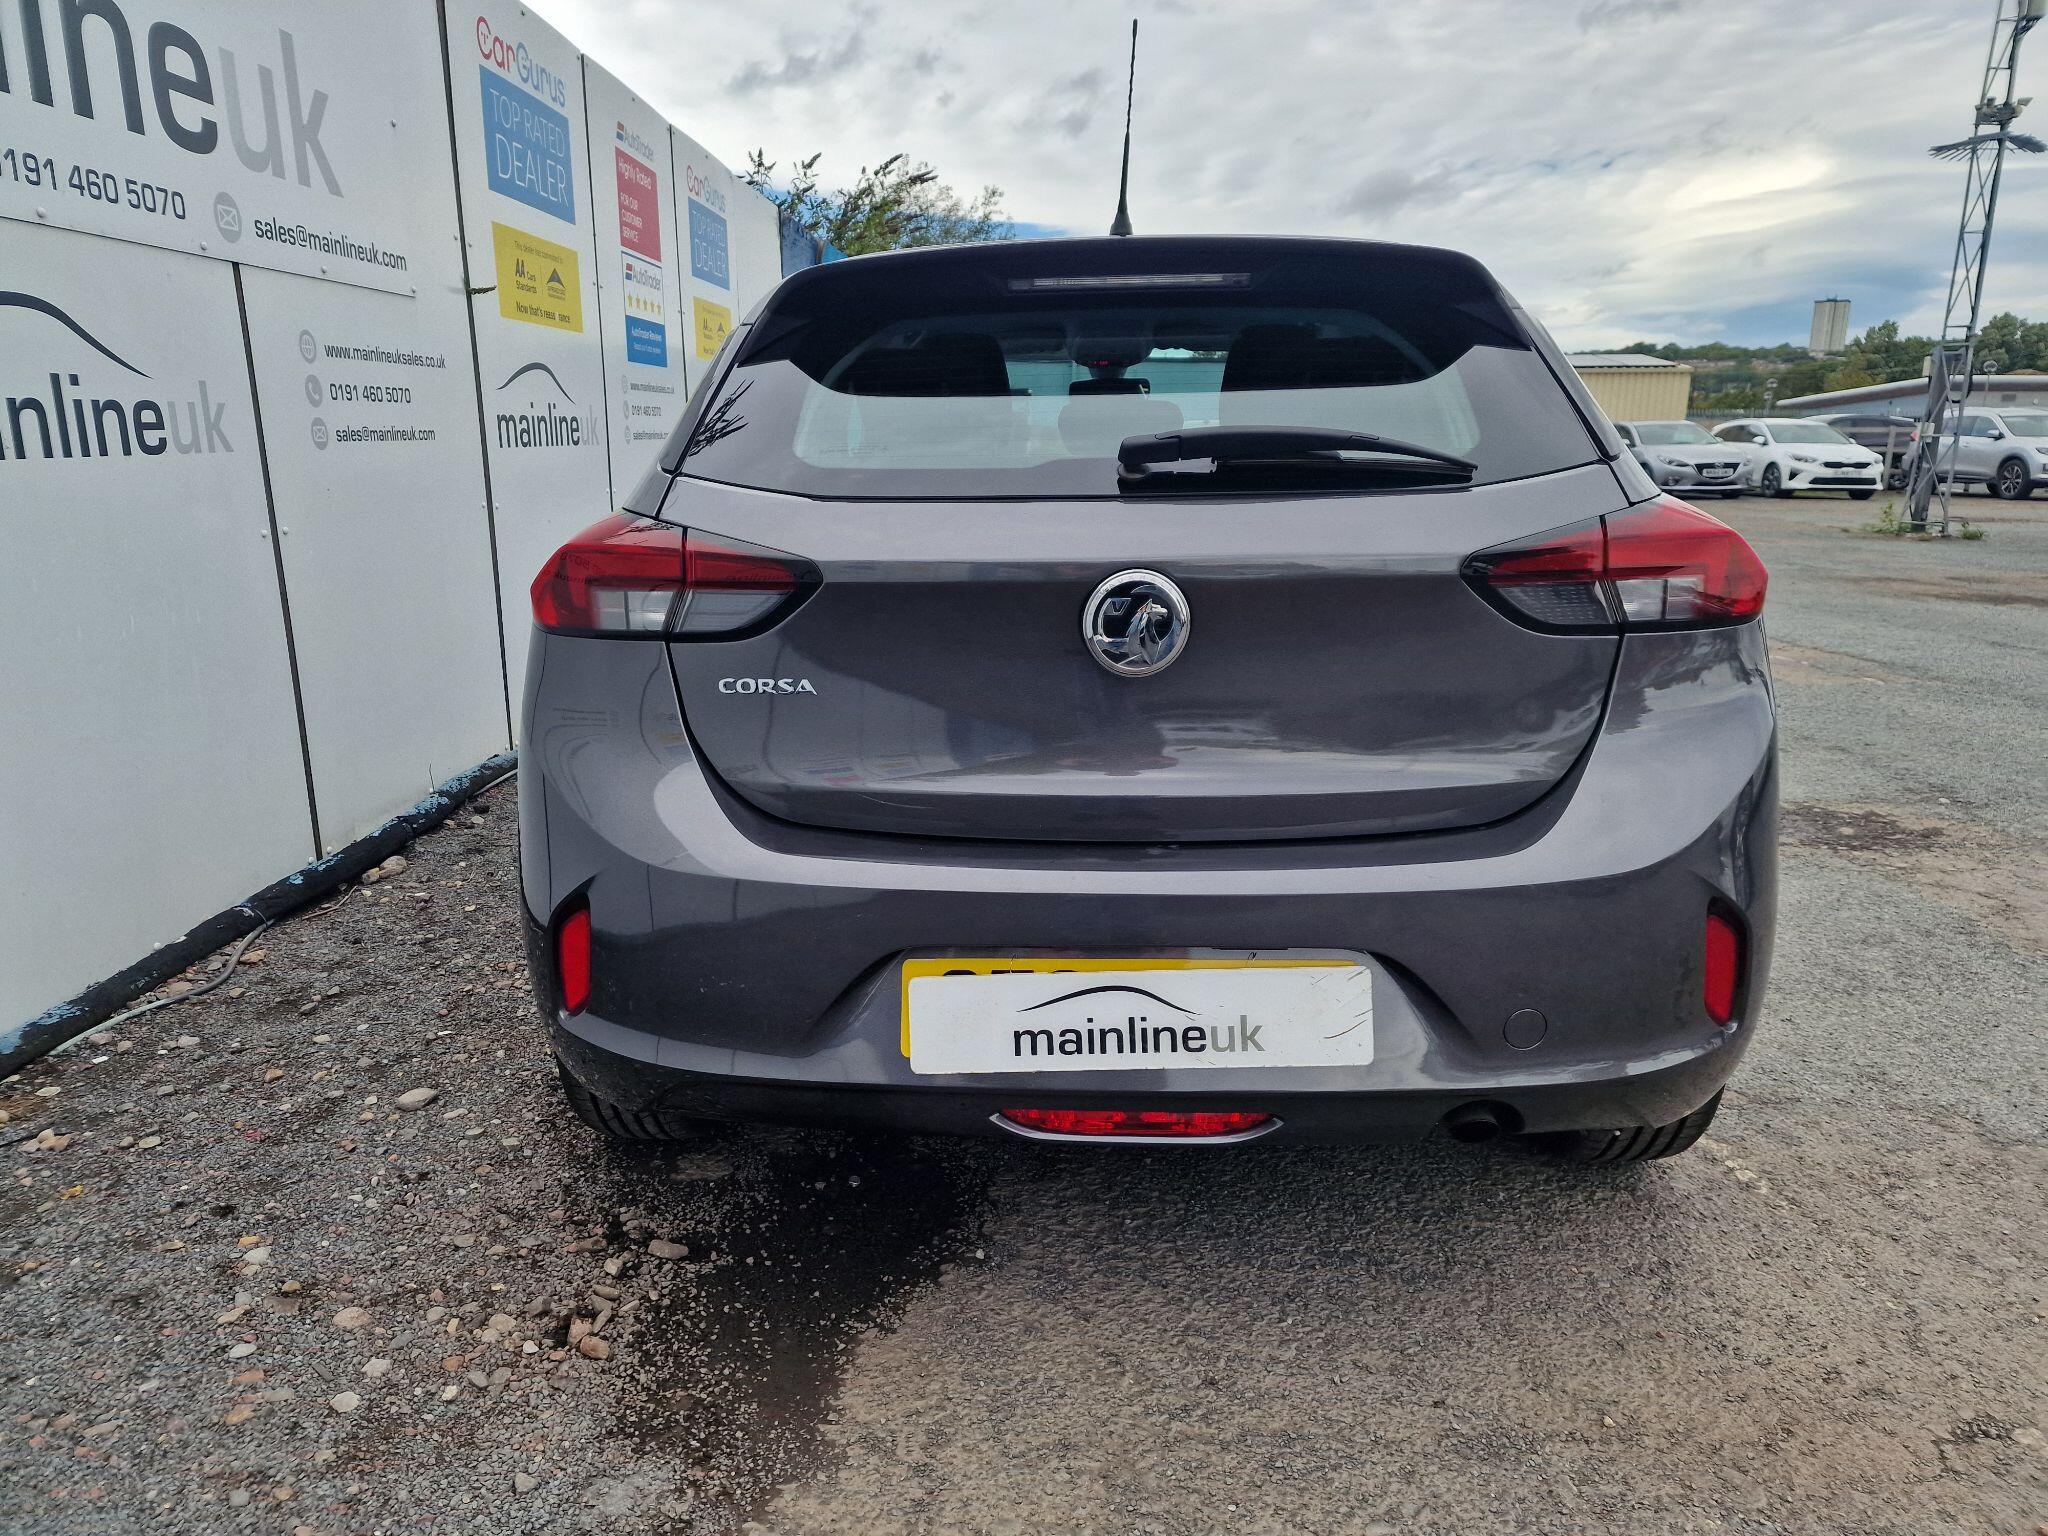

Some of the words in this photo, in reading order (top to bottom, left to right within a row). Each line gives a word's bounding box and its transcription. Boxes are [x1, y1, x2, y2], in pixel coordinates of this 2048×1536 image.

[476, 15, 566, 108] CarGurus
[489, 88, 520, 132] TOP
[523, 108, 566, 157] RATED
[0, 147, 57, 190] 191
[68, 164, 119, 204] 460
[124, 177, 186, 219] 5070
[495, 132, 569, 207] DEALER
[254, 217, 408, 271] sales@mainlineuk.com
[515, 258, 526, 278] AA
[324, 344, 447, 369] www.mainlineuksales.co.uk
[0, 372, 234, 461] nlineuk
[329, 382, 359, 402] 0191
[362, 385, 383, 403] 460
[385, 386, 412, 405] 5070
[335, 425, 437, 443] sales@mainlineuk.com
[496, 401, 600, 449] mainlineuk
[718, 677, 818, 696] CORSA
[1013, 1014, 1266, 1057] mainlineuk
